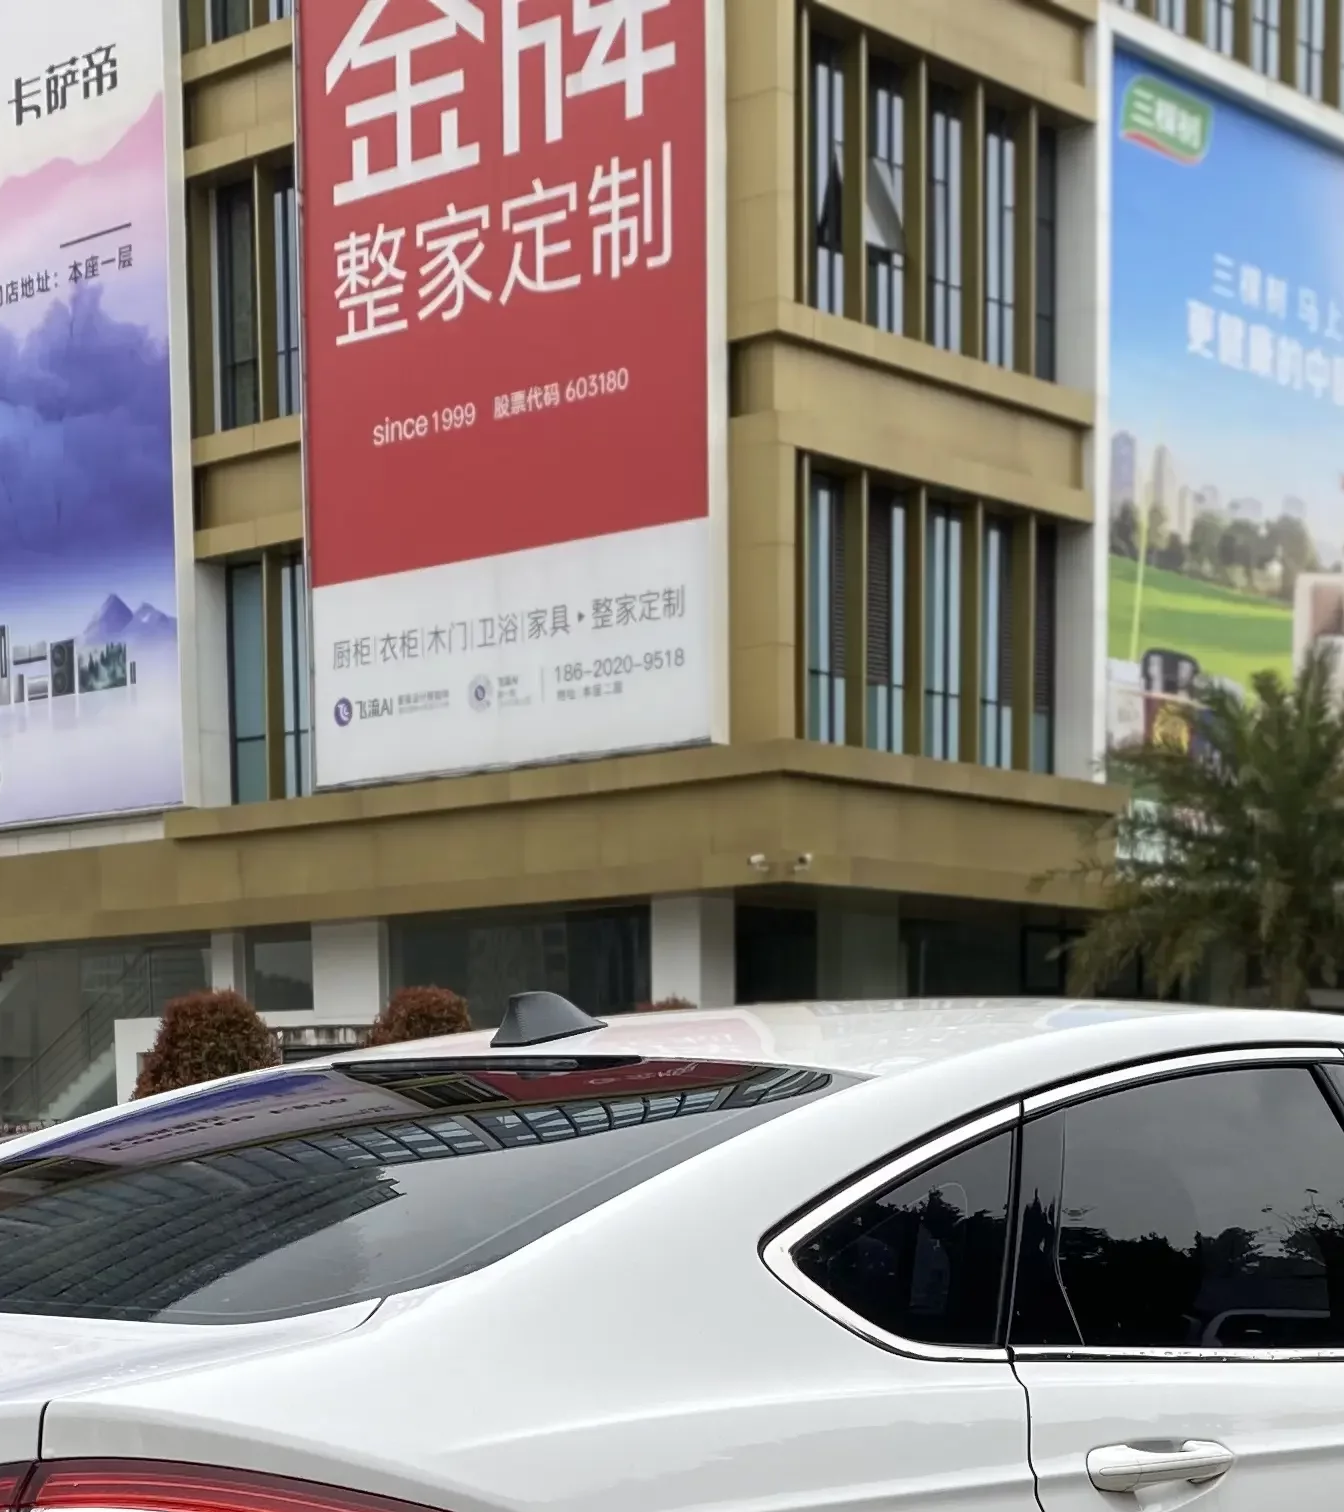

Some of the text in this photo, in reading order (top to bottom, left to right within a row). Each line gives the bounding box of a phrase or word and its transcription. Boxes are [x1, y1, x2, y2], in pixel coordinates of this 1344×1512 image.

[8, 43, 118, 126] 卡萨帝
[325, 0, 677, 206] 金牌
[334, 141, 673, 347] 整家定制
[373, 367, 630, 446] since 1999 股票代码 603180
[555, 648, 685, 683] 186-2020-9518
